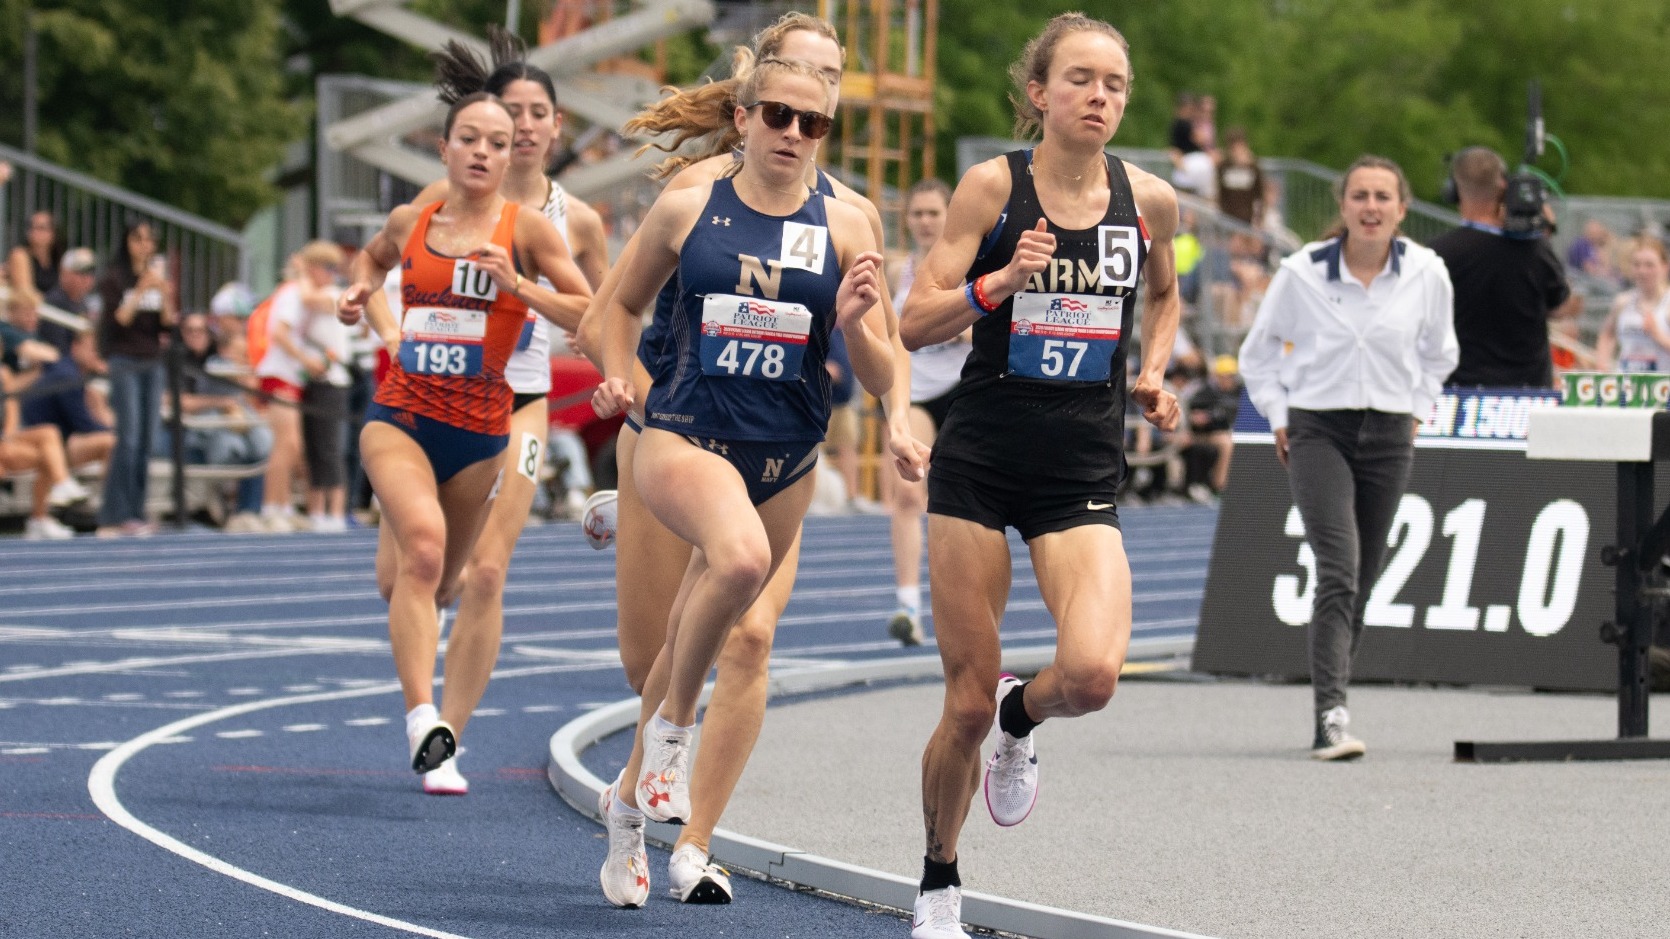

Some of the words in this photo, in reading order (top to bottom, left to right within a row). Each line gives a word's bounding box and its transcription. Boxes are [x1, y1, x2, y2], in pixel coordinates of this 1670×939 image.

[789, 227, 819, 268] 4
[1104, 230, 1132, 282] 5
[458, 262, 492, 296] 10
[735, 253, 786, 300] N
[1024, 258, 1124, 296] ARM
[733, 318, 778, 329] LEAGUE
[734, 312, 779, 323] PATRIOT
[1045, 316, 1090, 326] LEAGUE
[1046, 309, 1091, 319] PATRIOT
[413, 343, 467, 374] 193
[716, 340, 785, 379] 478
[1040, 339, 1088, 377] 57
[525, 438, 538, 477] 8
[763, 458, 784, 477] N
